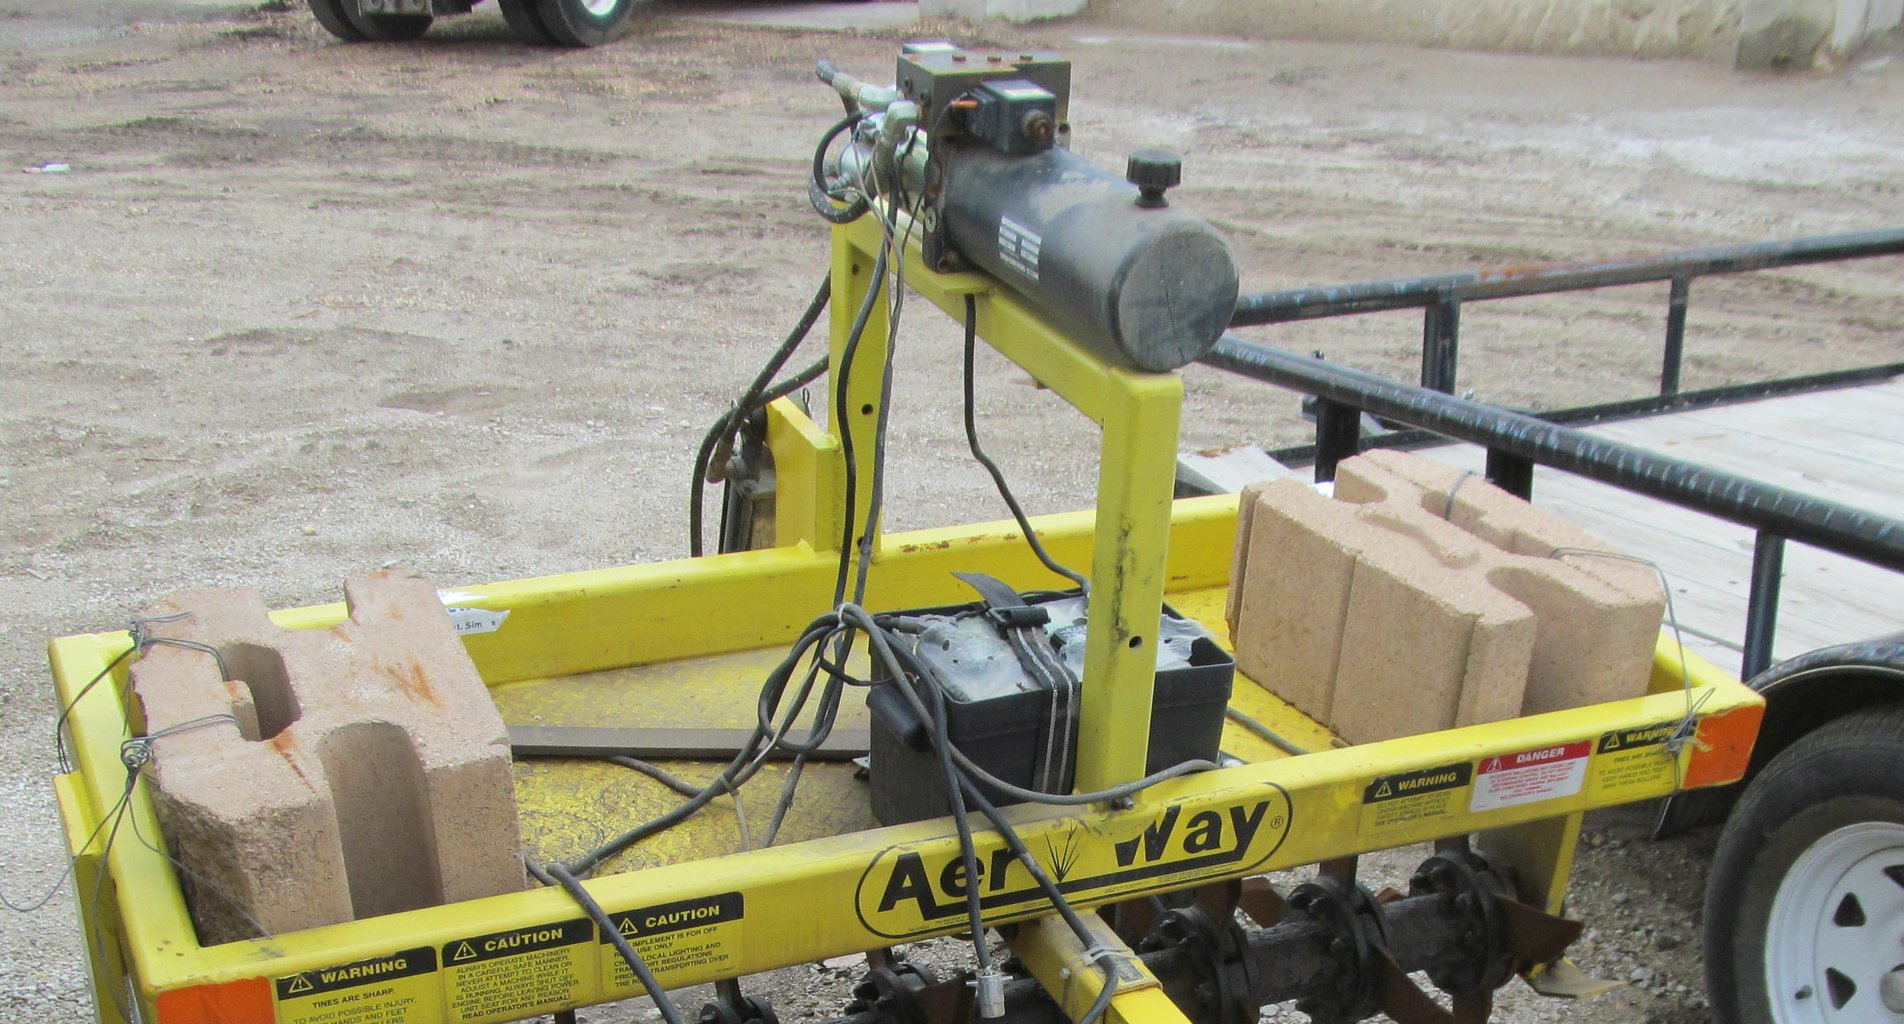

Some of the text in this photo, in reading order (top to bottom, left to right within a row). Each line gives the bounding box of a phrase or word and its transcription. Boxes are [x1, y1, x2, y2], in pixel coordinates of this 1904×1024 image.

[1517, 747, 1565, 763] DANGER
[1399, 772, 1456, 790] WARNING
[645, 905, 720, 928] CAUTION
[485, 928, 562, 951] CAUTION
[633, 935, 675, 947] IMPLEMENT
[654, 942, 673, 950] ONLY
[456, 962, 487, 973] ALWAYS
[526, 948, 571, 960] MACHINERY
[642, 952, 666, 961] LOCAL
[669, 945, 703, 956] LIGHTING
[662, 951, 713, 964] REGULATIONS
[321, 958, 407, 984] WARNING
[513, 961, 534, 970] SAFE
[651, 959, 707, 974] TRANSPORTING
[709, 954, 729, 963] OVER
[456, 977, 483, 987] NEVER
[485, 970, 519, 981] ATTEMPT
[534, 963, 559, 973] CLEAN
[461, 983, 491, 993] ADJUST
[500, 975, 534, 986] MACHINE
[537, 970, 560, 979] WHILE
[505, 981, 535, 991] ALWAYS
[537, 977, 557, 985] SHUT
[313, 998, 339, 1009] TINES
[342, 994, 360, 1003] ARE
[452, 980, 579, 1009] ENGINE BEFORE LEAVING POWER
[461, 1005, 478, 1013] UNIT
[481, 1001, 499, 1010] SEAT
[520, 995, 535, 1003] ANY
[537, 989, 569, 1000] REASON
[309, 1012, 336, 1023] AVOID
[338, 1004, 381, 1017] POSSIBLE
[365, 1012, 383, 1021] AND
[386, 1007, 408, 1017] FEET
[462, 1010, 484, 1020] READ
